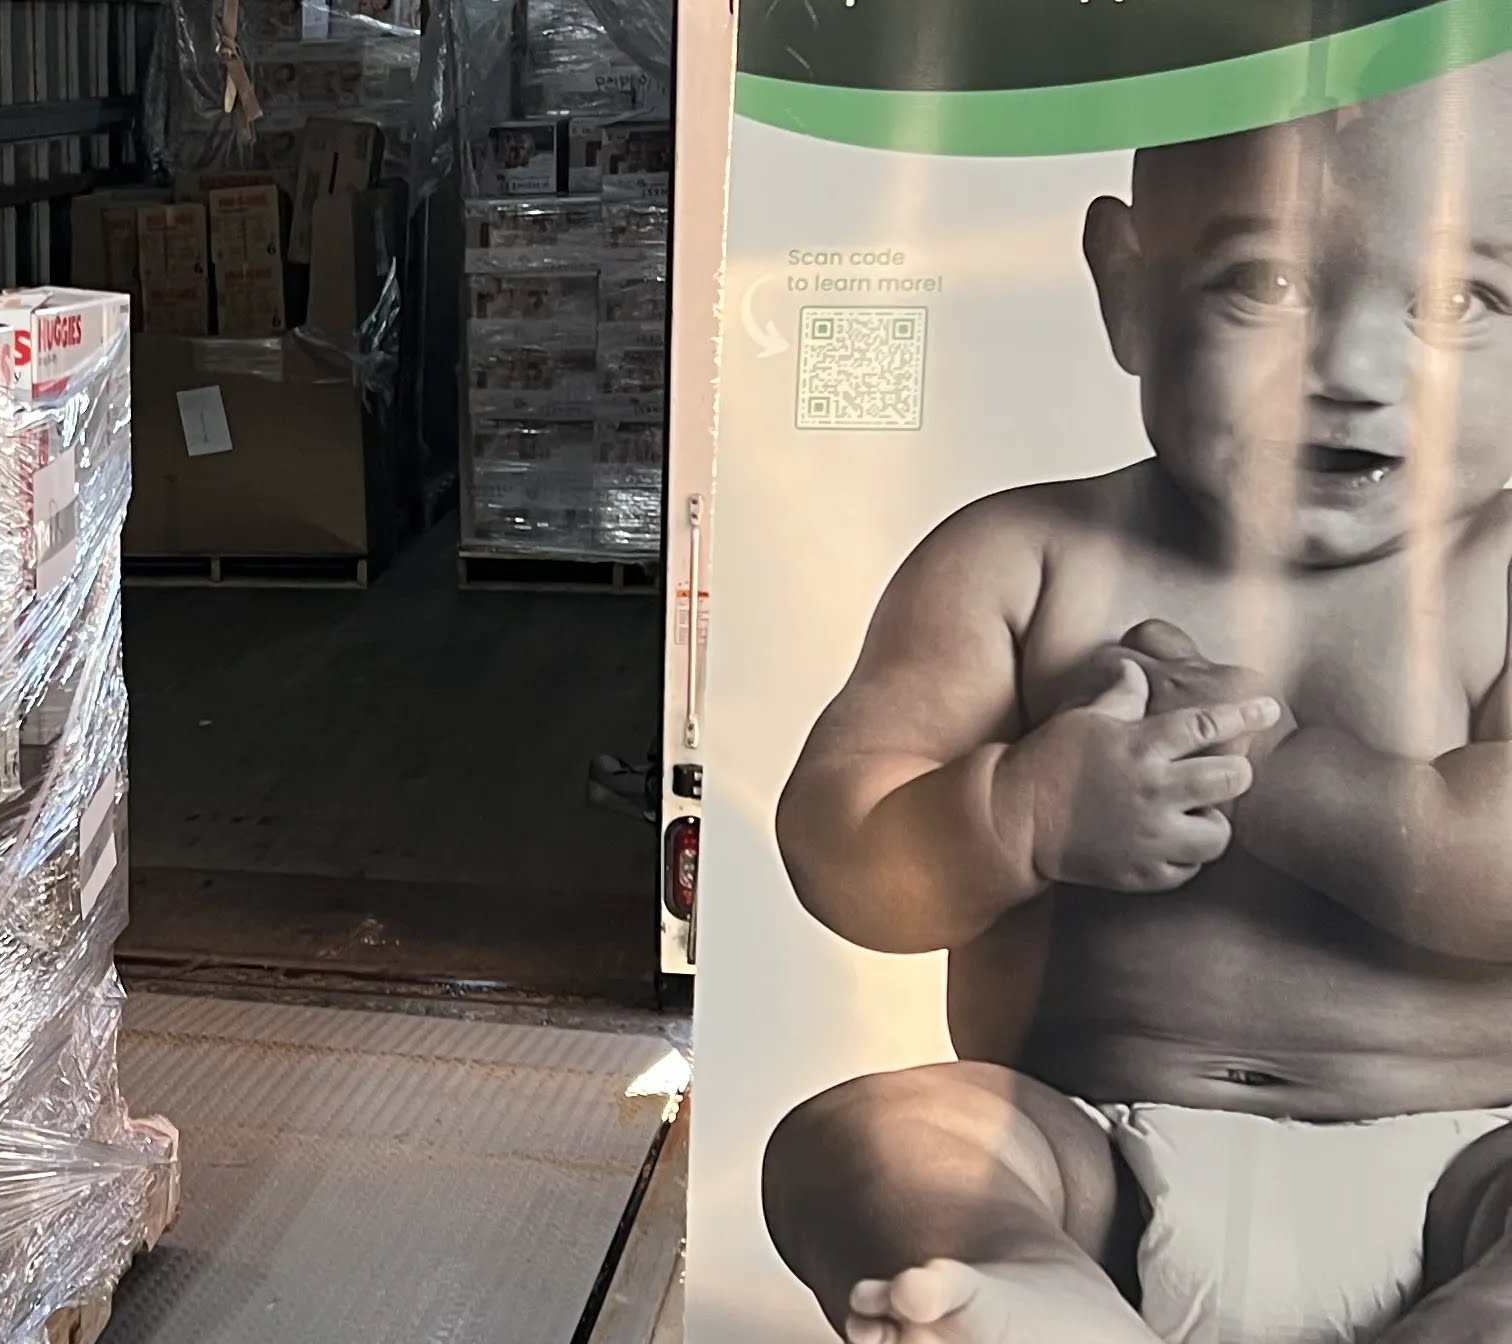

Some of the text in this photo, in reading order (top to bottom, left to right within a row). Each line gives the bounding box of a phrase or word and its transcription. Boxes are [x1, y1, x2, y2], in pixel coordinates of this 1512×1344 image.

[787, 248, 906, 267] Scan code
[787, 274, 944, 293] to learn more!
